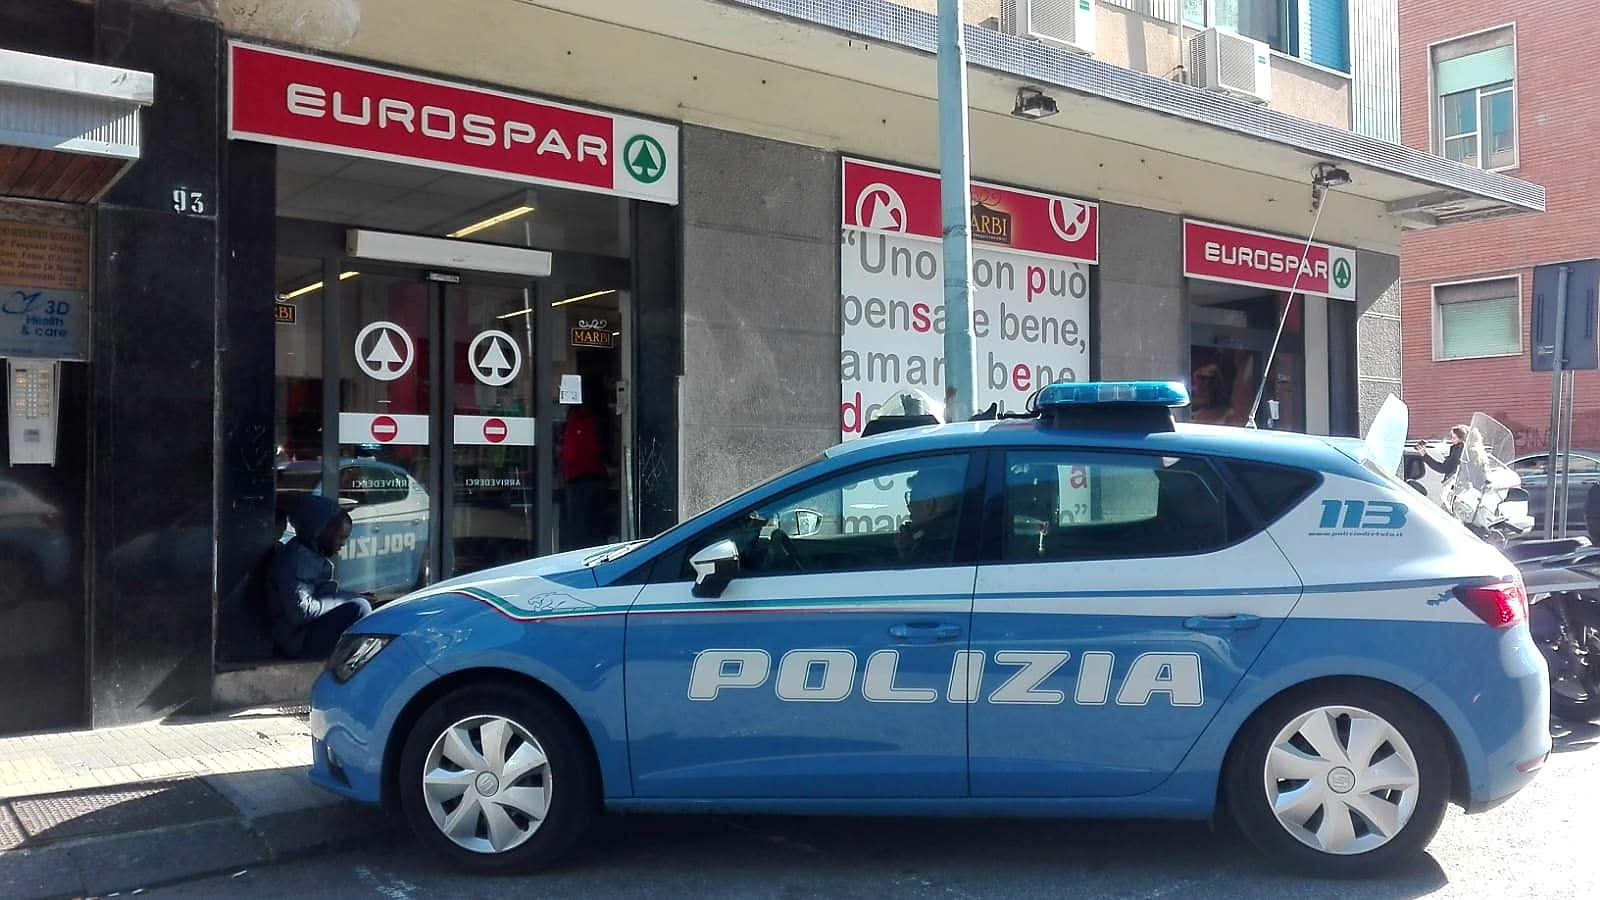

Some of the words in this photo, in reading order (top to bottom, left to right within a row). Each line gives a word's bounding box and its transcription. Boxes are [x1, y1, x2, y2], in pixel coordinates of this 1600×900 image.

[286, 83, 608, 166] EUROSPAR
[173, 188, 204, 213] 93
[972, 214, 1007, 236] ARBI
[1204, 241, 1328, 279] EUROSPAR
[973, 258, 1014, 290] on
[1027, 263, 1087, 302] può
[26, 315, 64, 327] Health
[45, 300, 70, 315] 3D
[275, 306, 293, 320] BI
[35, 328, 68, 338] care
[841, 294, 989, 338] pensae
[1000, 302, 1086, 354] bene,
[841, 350, 944, 386] amar
[1319, 499, 1409, 529] 113
[687, 649, 1204, 706] POLIZIA
